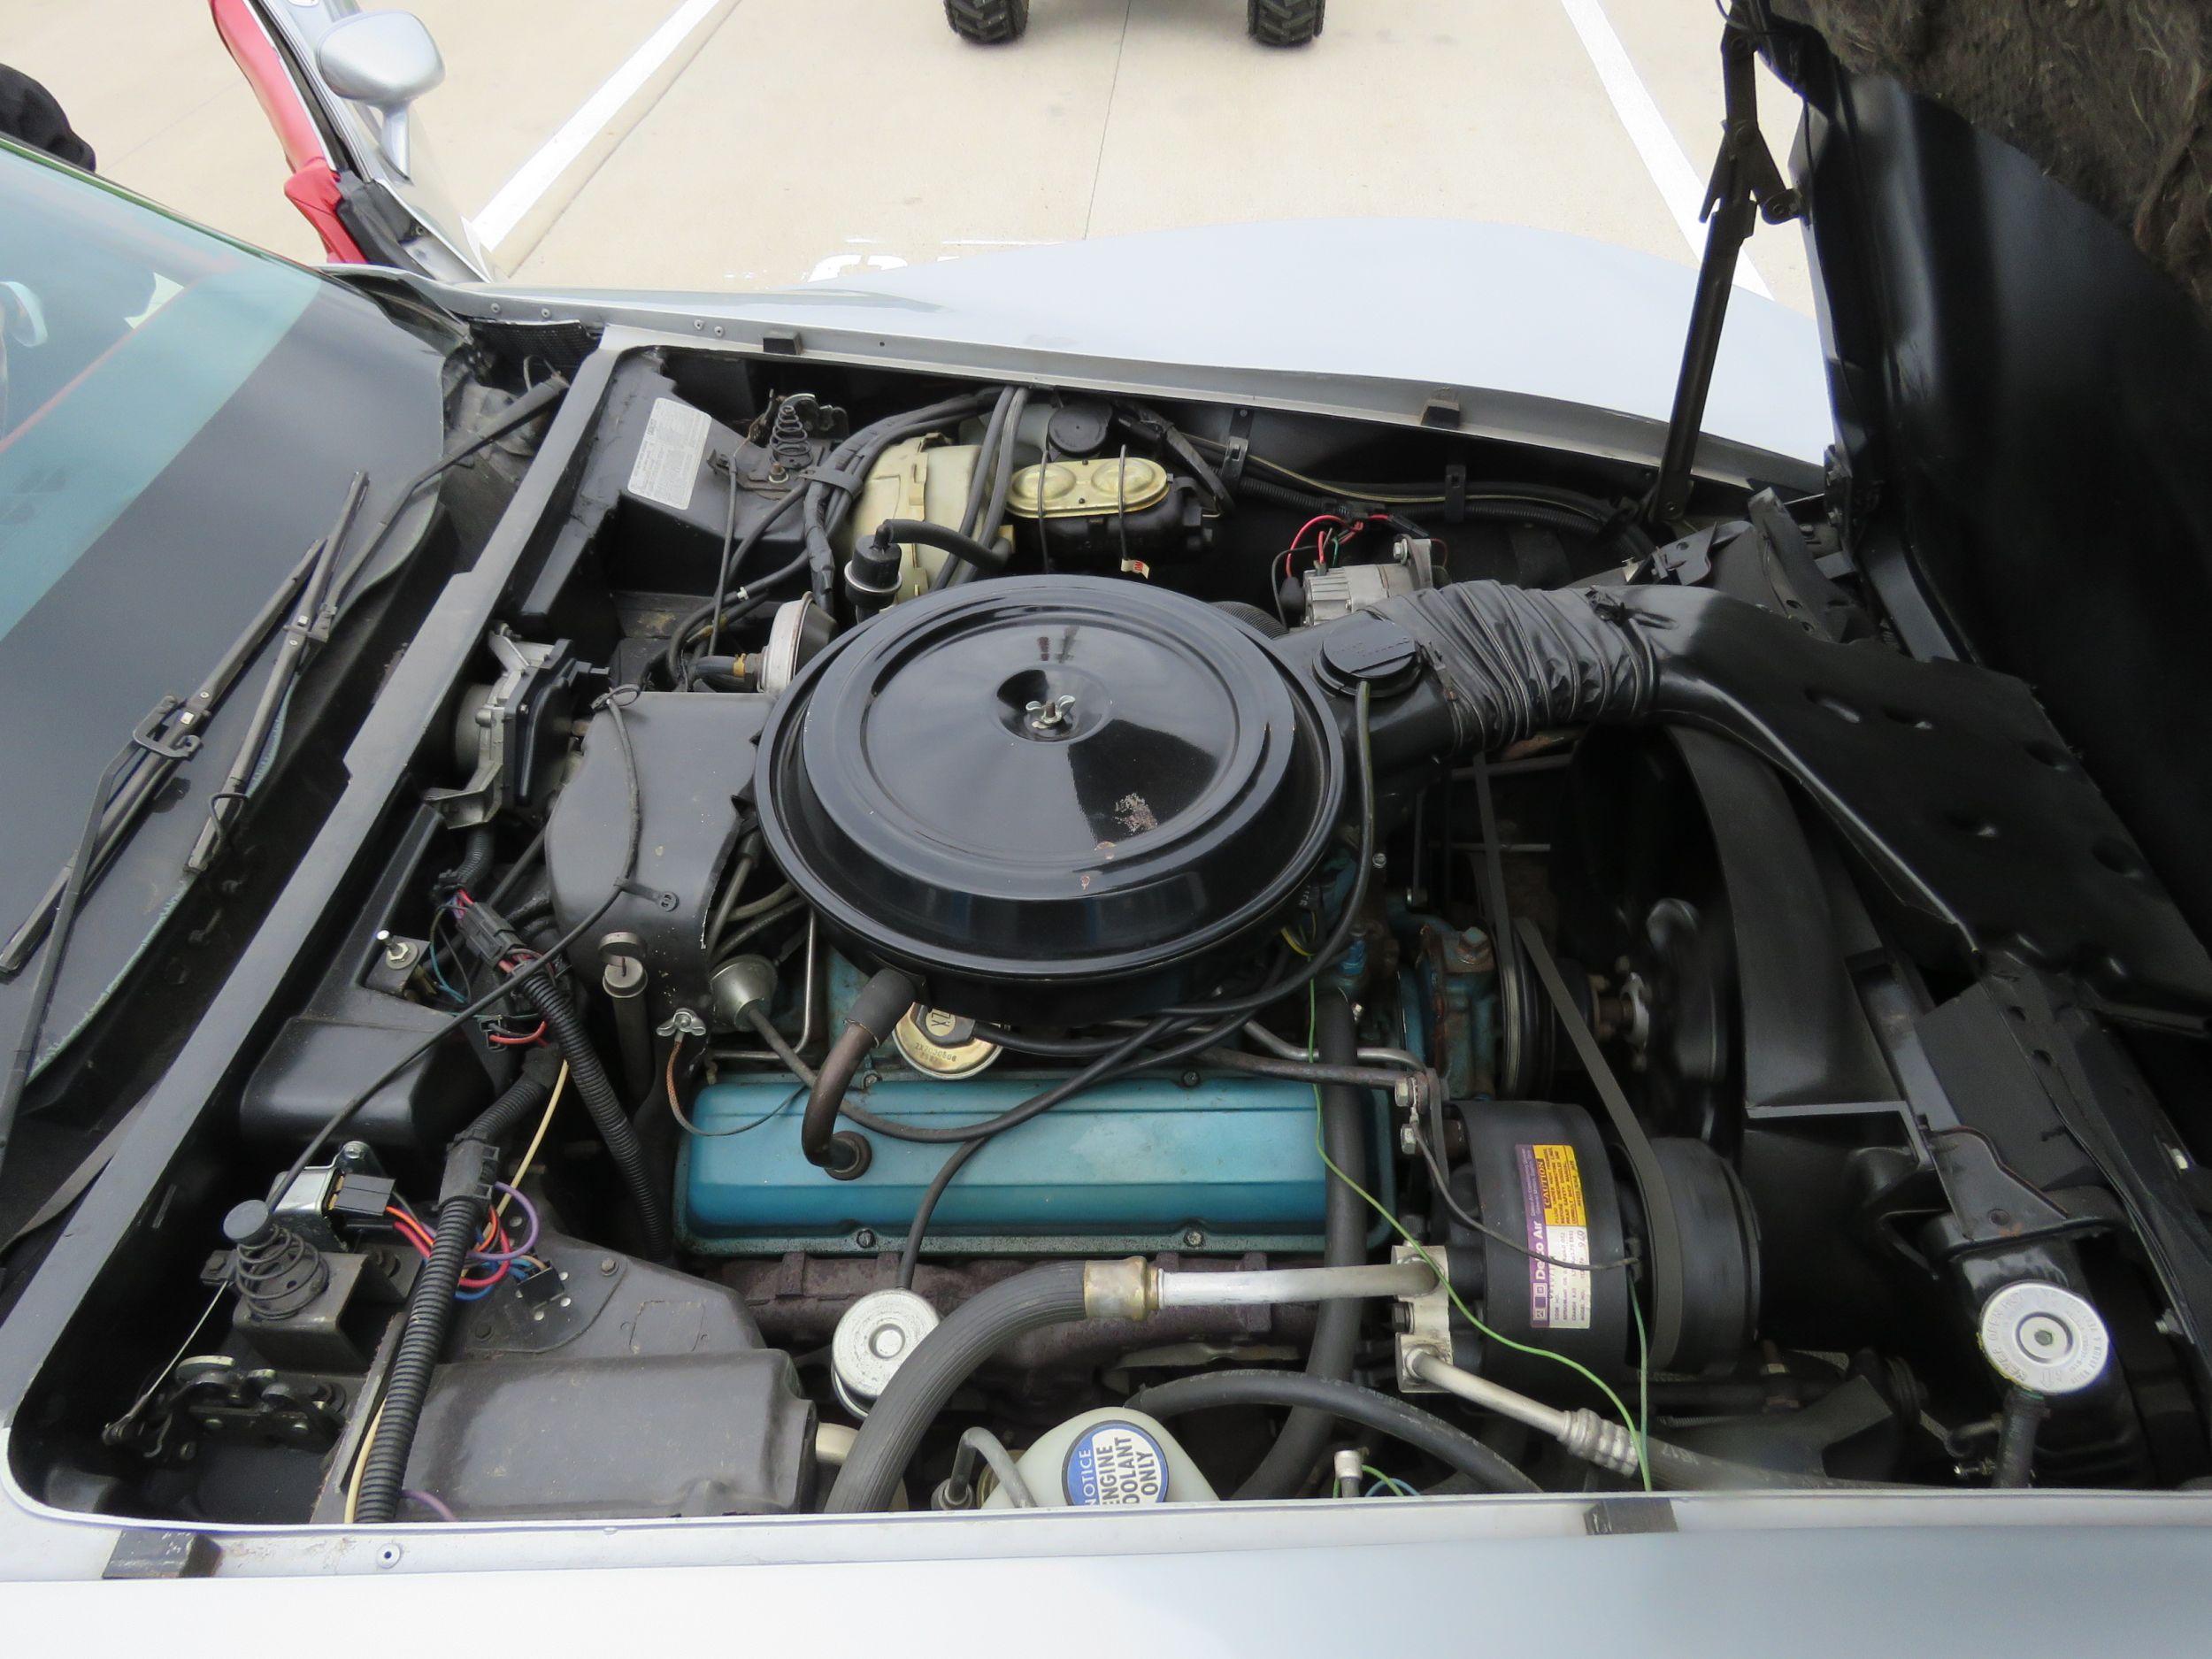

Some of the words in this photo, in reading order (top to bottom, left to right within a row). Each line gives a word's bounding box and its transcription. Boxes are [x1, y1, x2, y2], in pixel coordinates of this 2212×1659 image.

[1538, 1161, 1551, 1206] CAUTION
[1533, 1221, 1544, 1240] Air
[1114, 1437, 1140, 1504] OOLANT
[1136, 1451, 1159, 1495] ONLY
